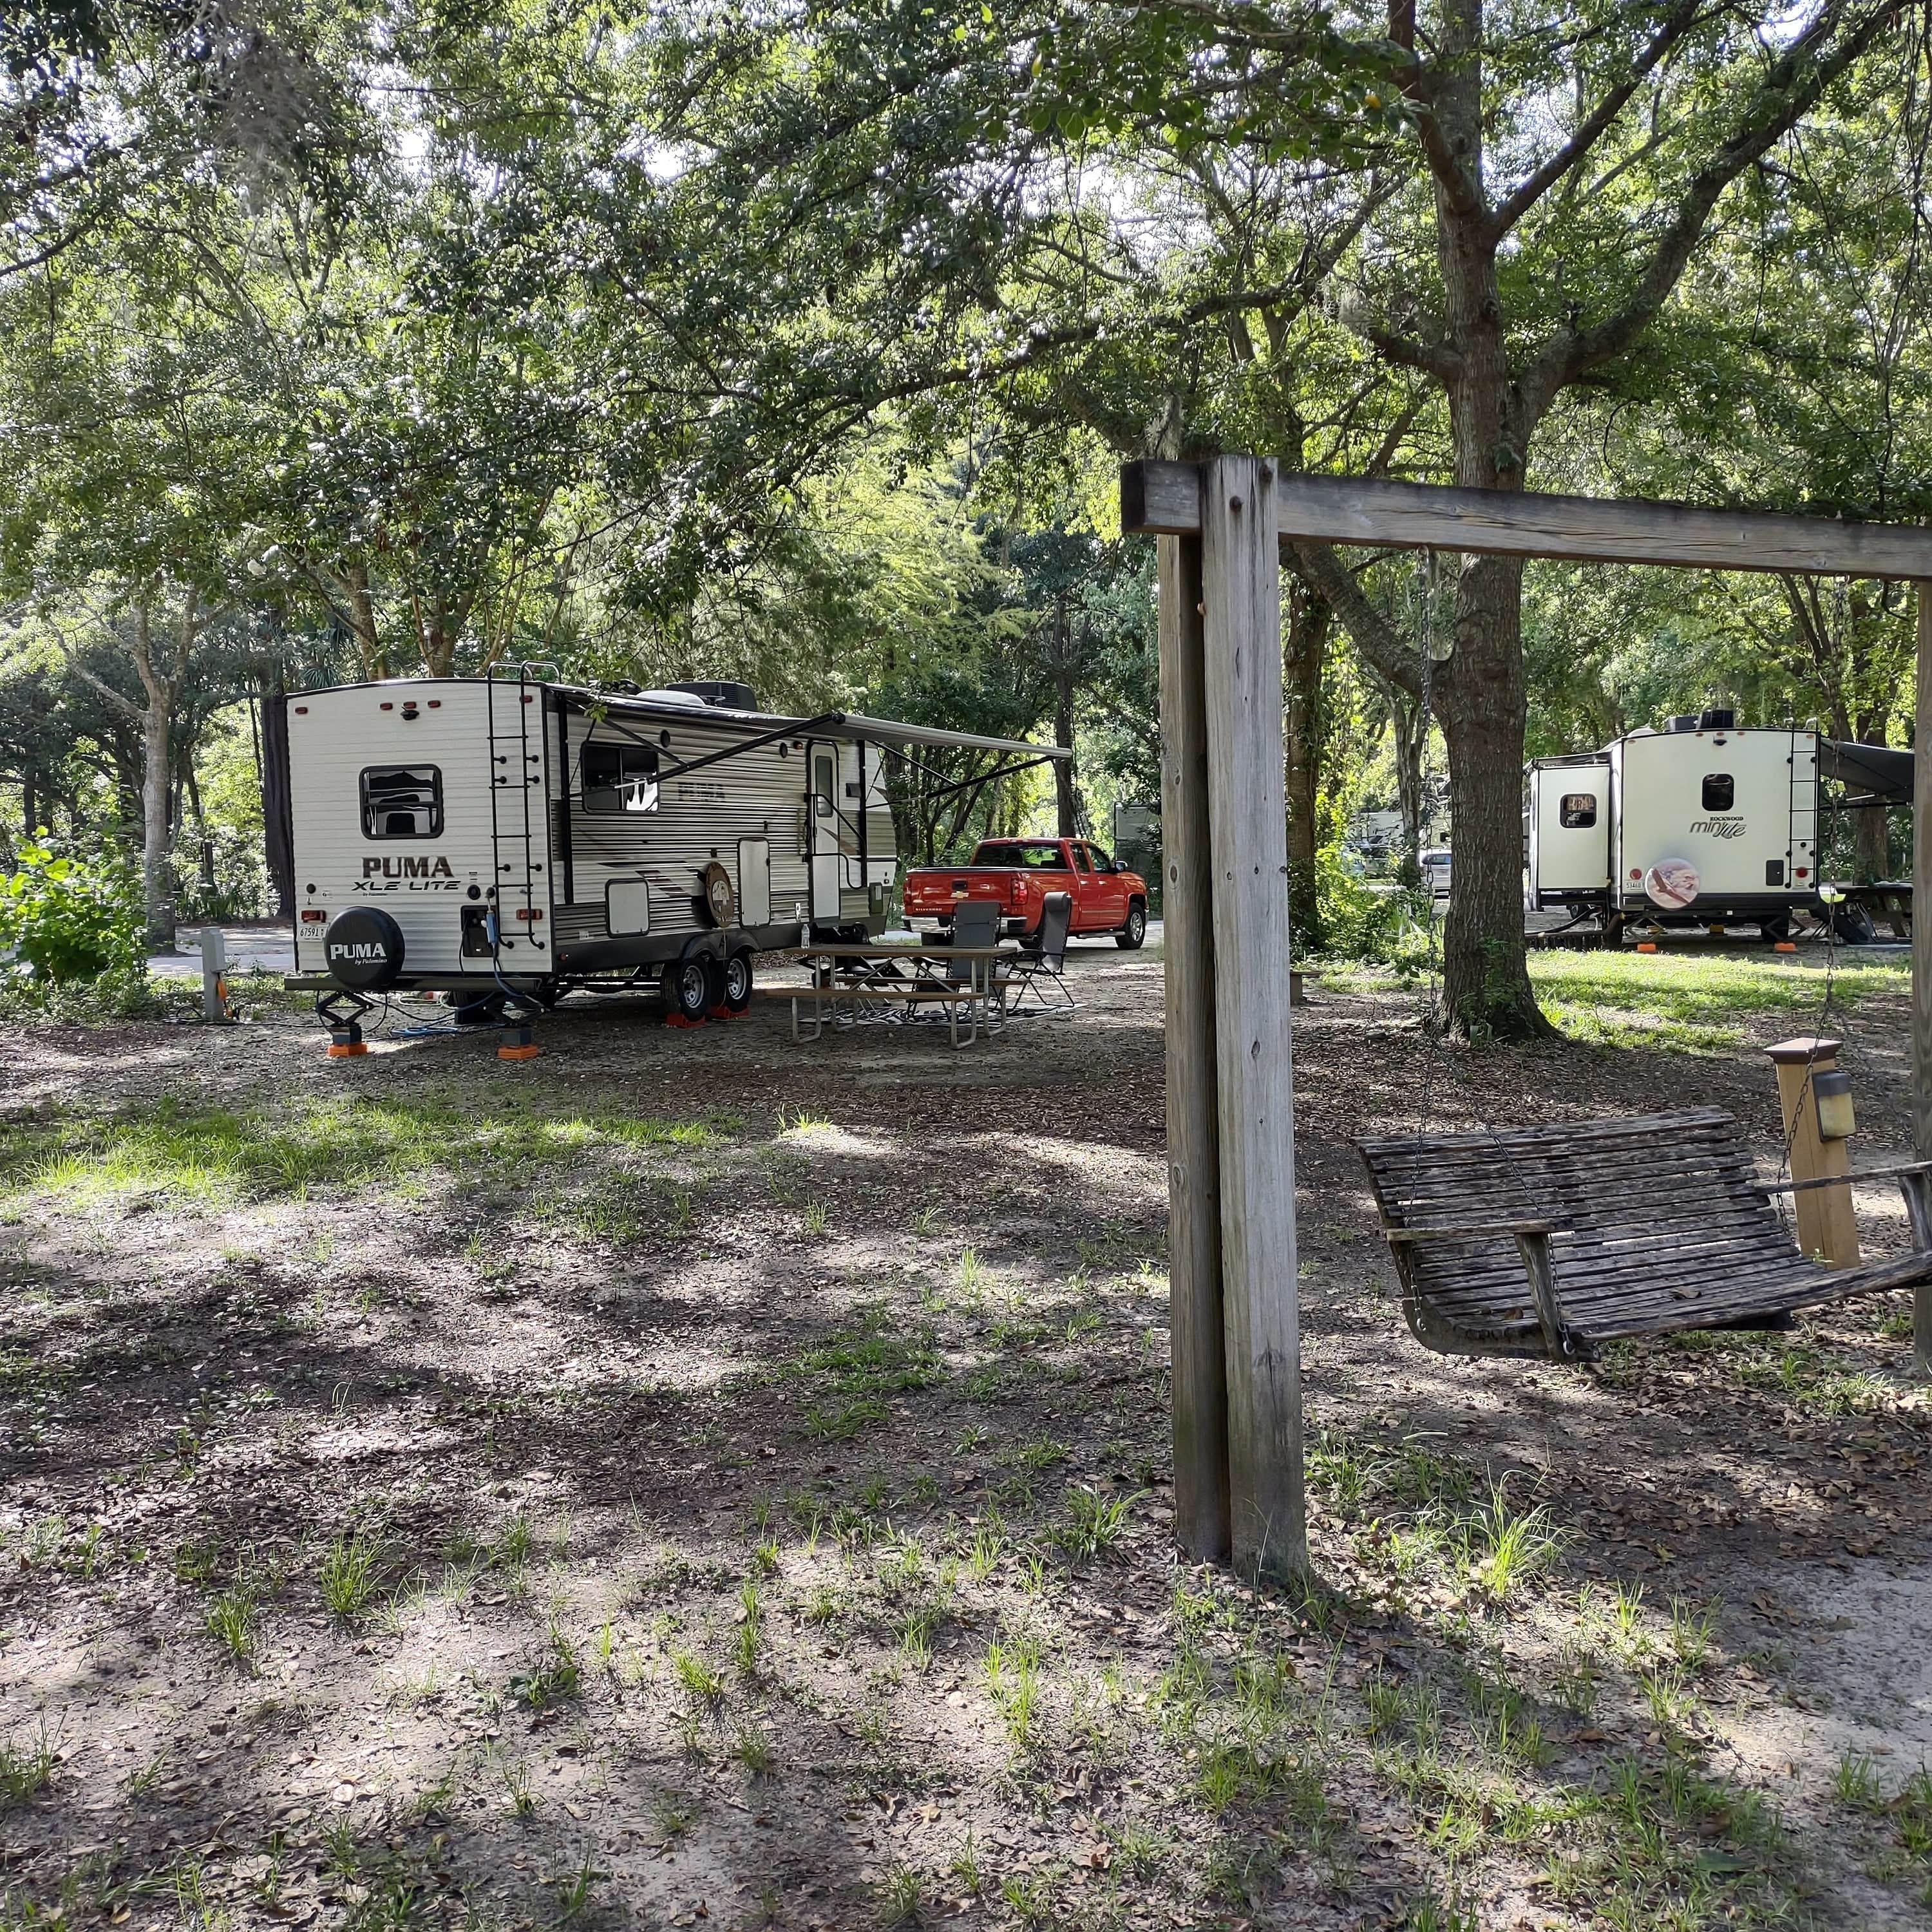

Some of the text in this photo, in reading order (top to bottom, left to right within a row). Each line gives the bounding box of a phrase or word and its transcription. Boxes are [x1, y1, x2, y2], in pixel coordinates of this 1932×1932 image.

[362, 856, 455, 878] PUMA
[352, 881, 461, 891] XLE LITE
[300, 927, 319, 936] 67591
[330, 943, 386, 960] PUMA
